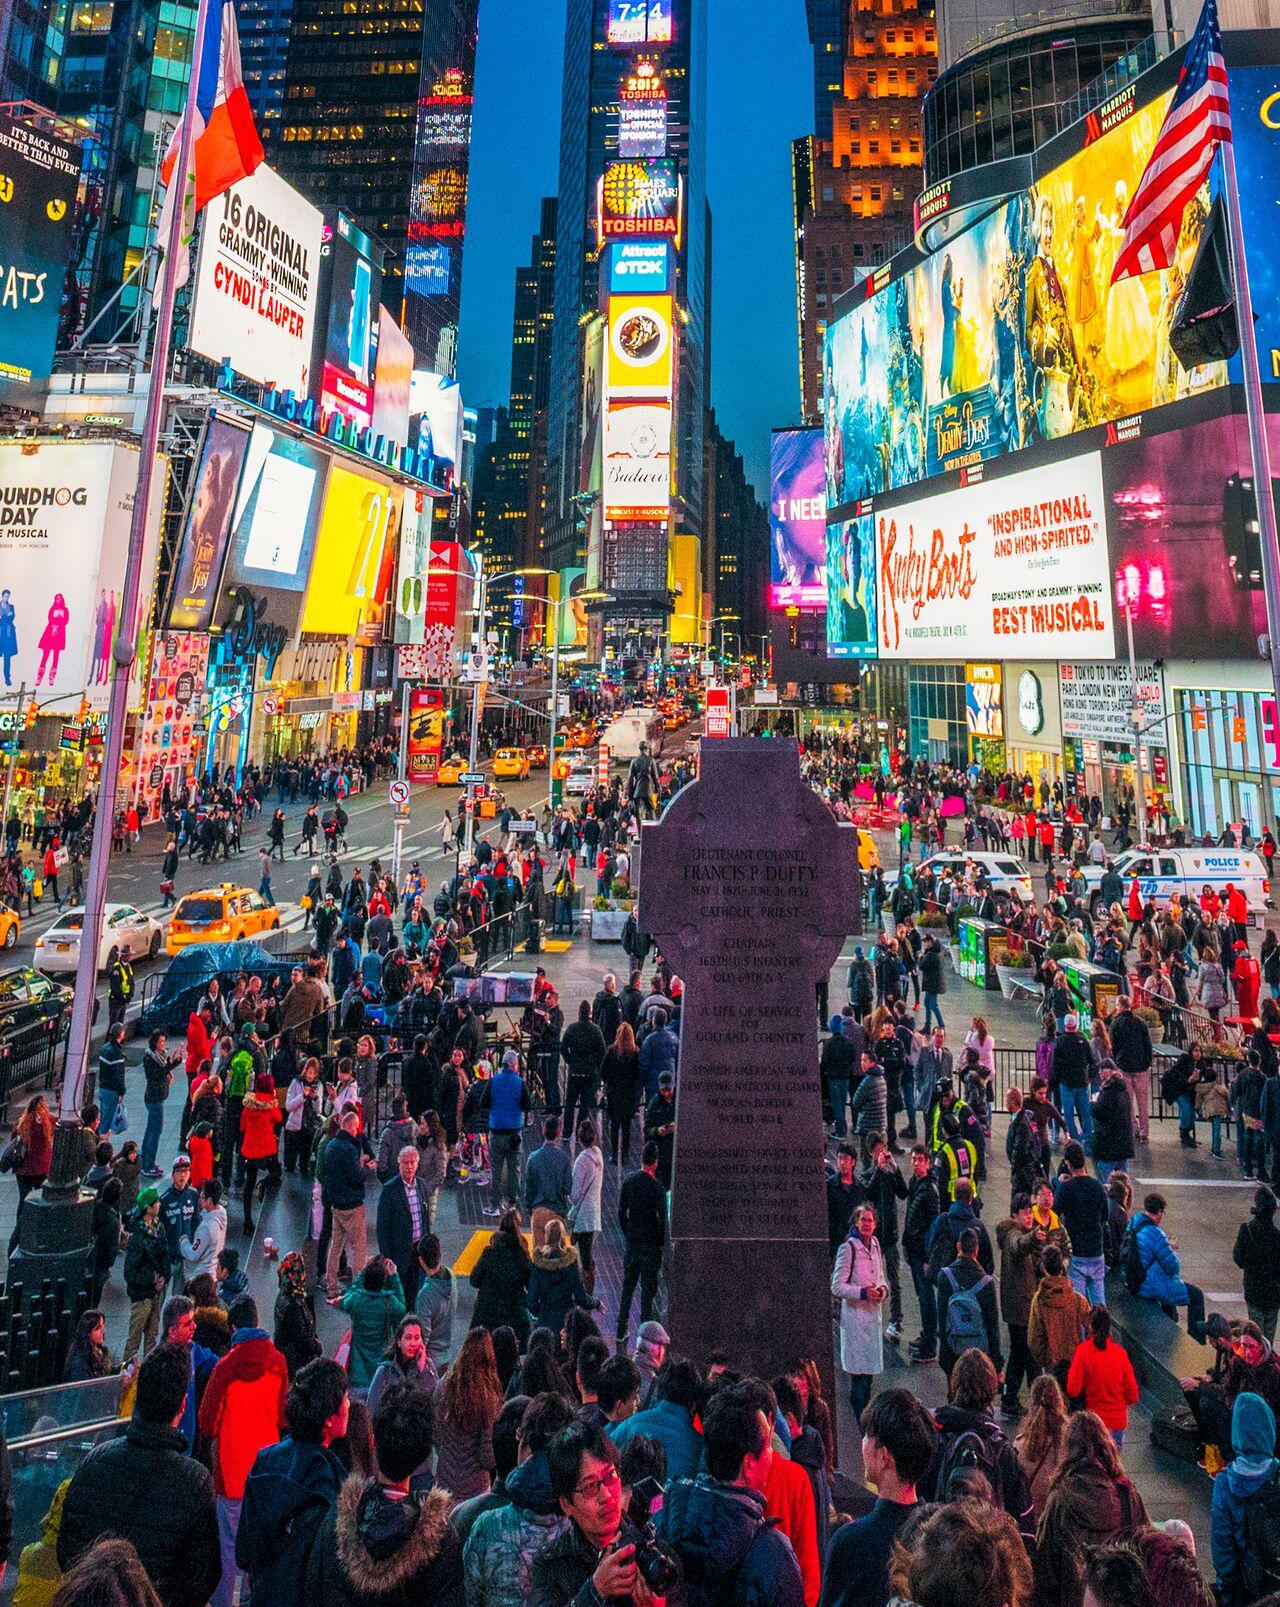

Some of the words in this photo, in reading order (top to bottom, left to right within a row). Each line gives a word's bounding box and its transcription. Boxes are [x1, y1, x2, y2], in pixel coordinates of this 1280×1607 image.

[627, 78, 660, 91] 2017
[620, 89, 667, 100] TOSHIBA
[1100, 84, 1136, 118] MARRIOTT
[1101, 101, 1134, 132] MARQUIS
[11, 125, 28, 142] IT'S
[28, 133, 51, 152] BACK
[50, 145, 69, 160] AND
[30, 147, 55, 166] THAN
[223, 188, 243, 229] 16
[245, 204, 310, 281] ORIGINAL
[603, 218, 677, 234] TOSHIBA
[214, 261, 256, 310] CYNDI
[257, 283, 305, 340] LAUPER
[1116, 415, 1142, 431] MARRIOTT
[1117, 426, 1141, 440] MARQUIS
[328, 410, 436, 484] BROADWAY
[0, 507, 39, 527] DAY
[6, 528, 48, 539] MUSICAL
[994, 538, 1013, 558] AND
[925, 522, 978, 603] Boots
[992, 605, 1028, 634] BEST
[1030, 595, 1105, 634] MUSICAL
[1074, 665, 1095, 680] TOKYO
[1096, 665, 1105, 680] TO
[1106, 665, 1128, 681] TIMES
[1061, 682, 1077, 696] PARIS
[1078, 683, 1101, 697] LONDON
[1102, 684, 1118, 698] NEW
[1204, 857, 1240, 867] POLICE
[682, 864, 746, 882] FRANCIS
[764, 865, 819, 882] DUFFY
[699, 905, 754, 918] CATHOLIC
[759, 905, 800, 918] PRIEST
